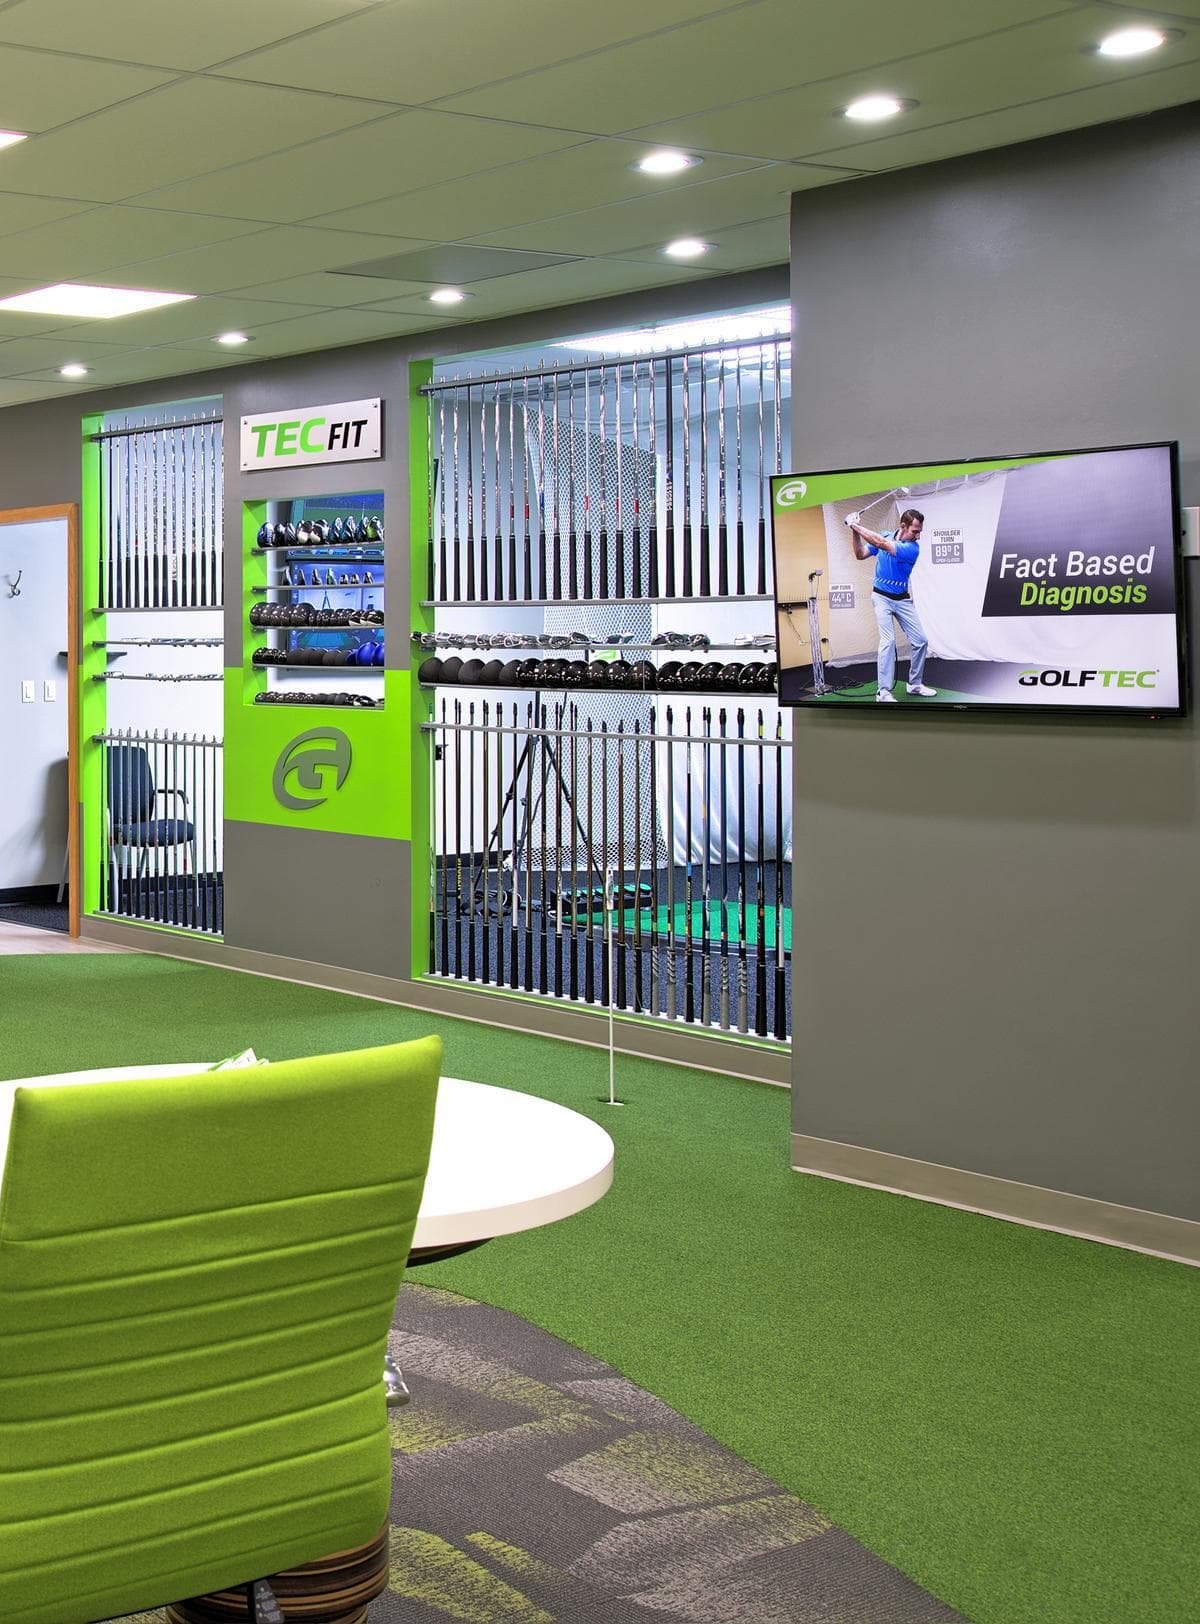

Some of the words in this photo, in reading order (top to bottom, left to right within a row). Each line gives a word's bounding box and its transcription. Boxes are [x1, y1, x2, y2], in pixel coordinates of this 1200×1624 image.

[251, 417, 326, 458] TEC
[327, 419, 368, 450] FIT
[999, 552, 1058, 579] Fact
[1066, 545, 1156, 577] Based
[1020, 577, 1148, 612] Diagnosis
[1018, 669, 1159, 688] GOLFTEC
